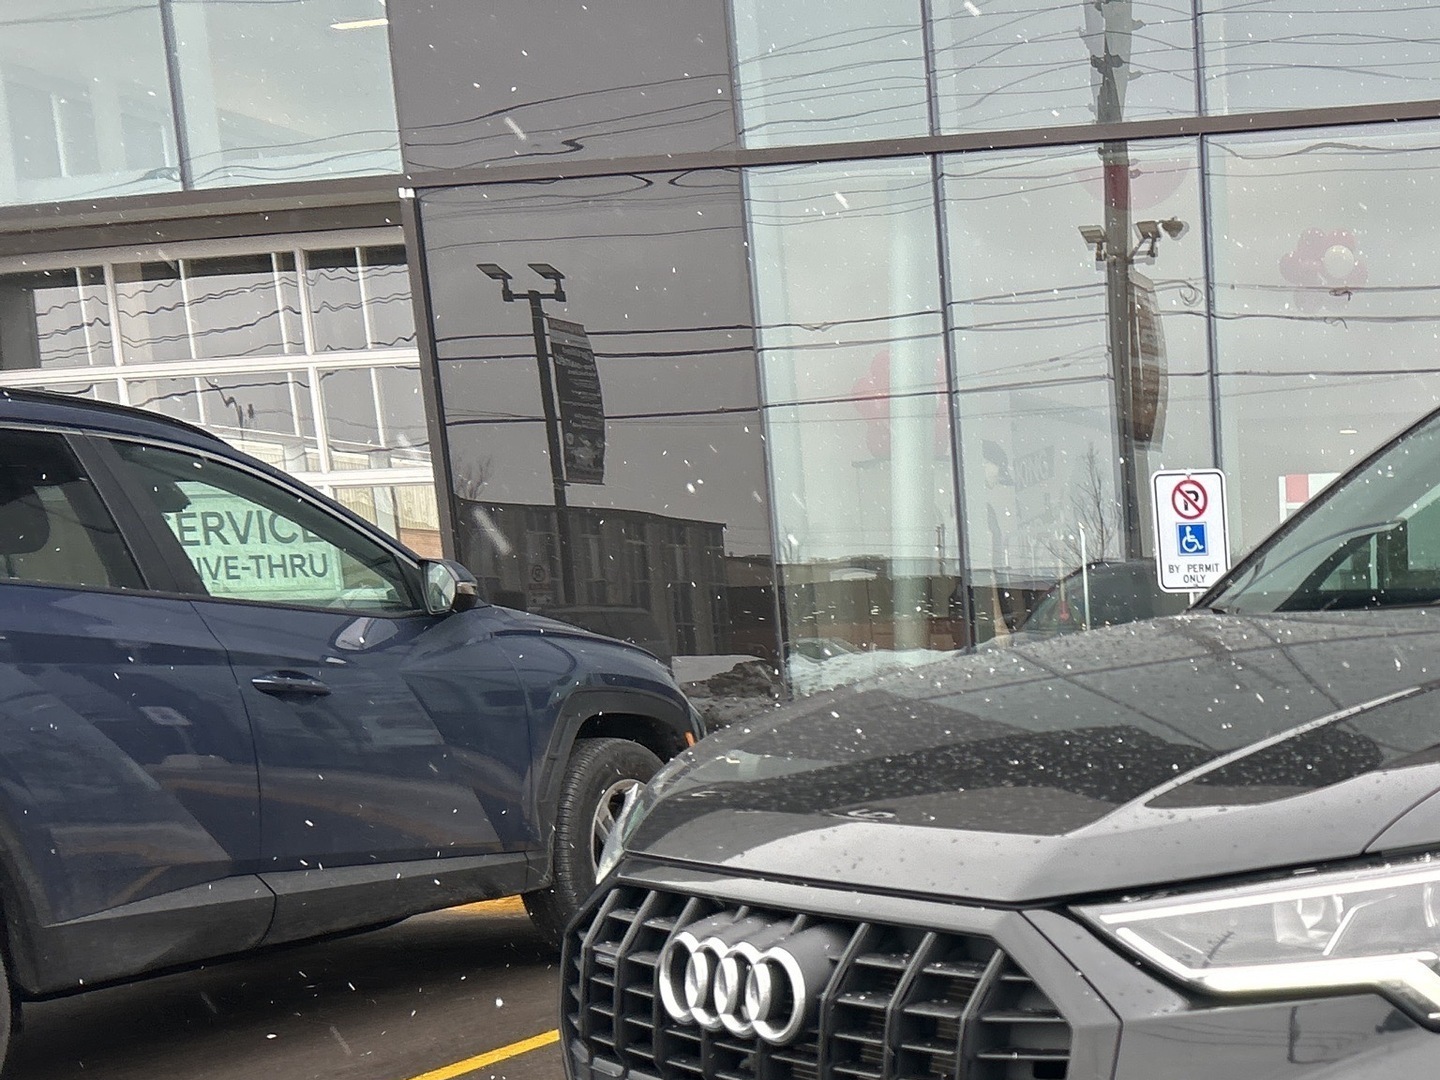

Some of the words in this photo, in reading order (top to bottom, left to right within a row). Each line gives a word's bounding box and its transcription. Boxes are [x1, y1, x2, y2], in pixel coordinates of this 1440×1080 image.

[168, 508, 325, 547] ERVIC
[1168, 564, 1181, 574] BY
[1187, 563, 1219, 573] PERMIT
[1183, 574, 1206, 584] ONLY
